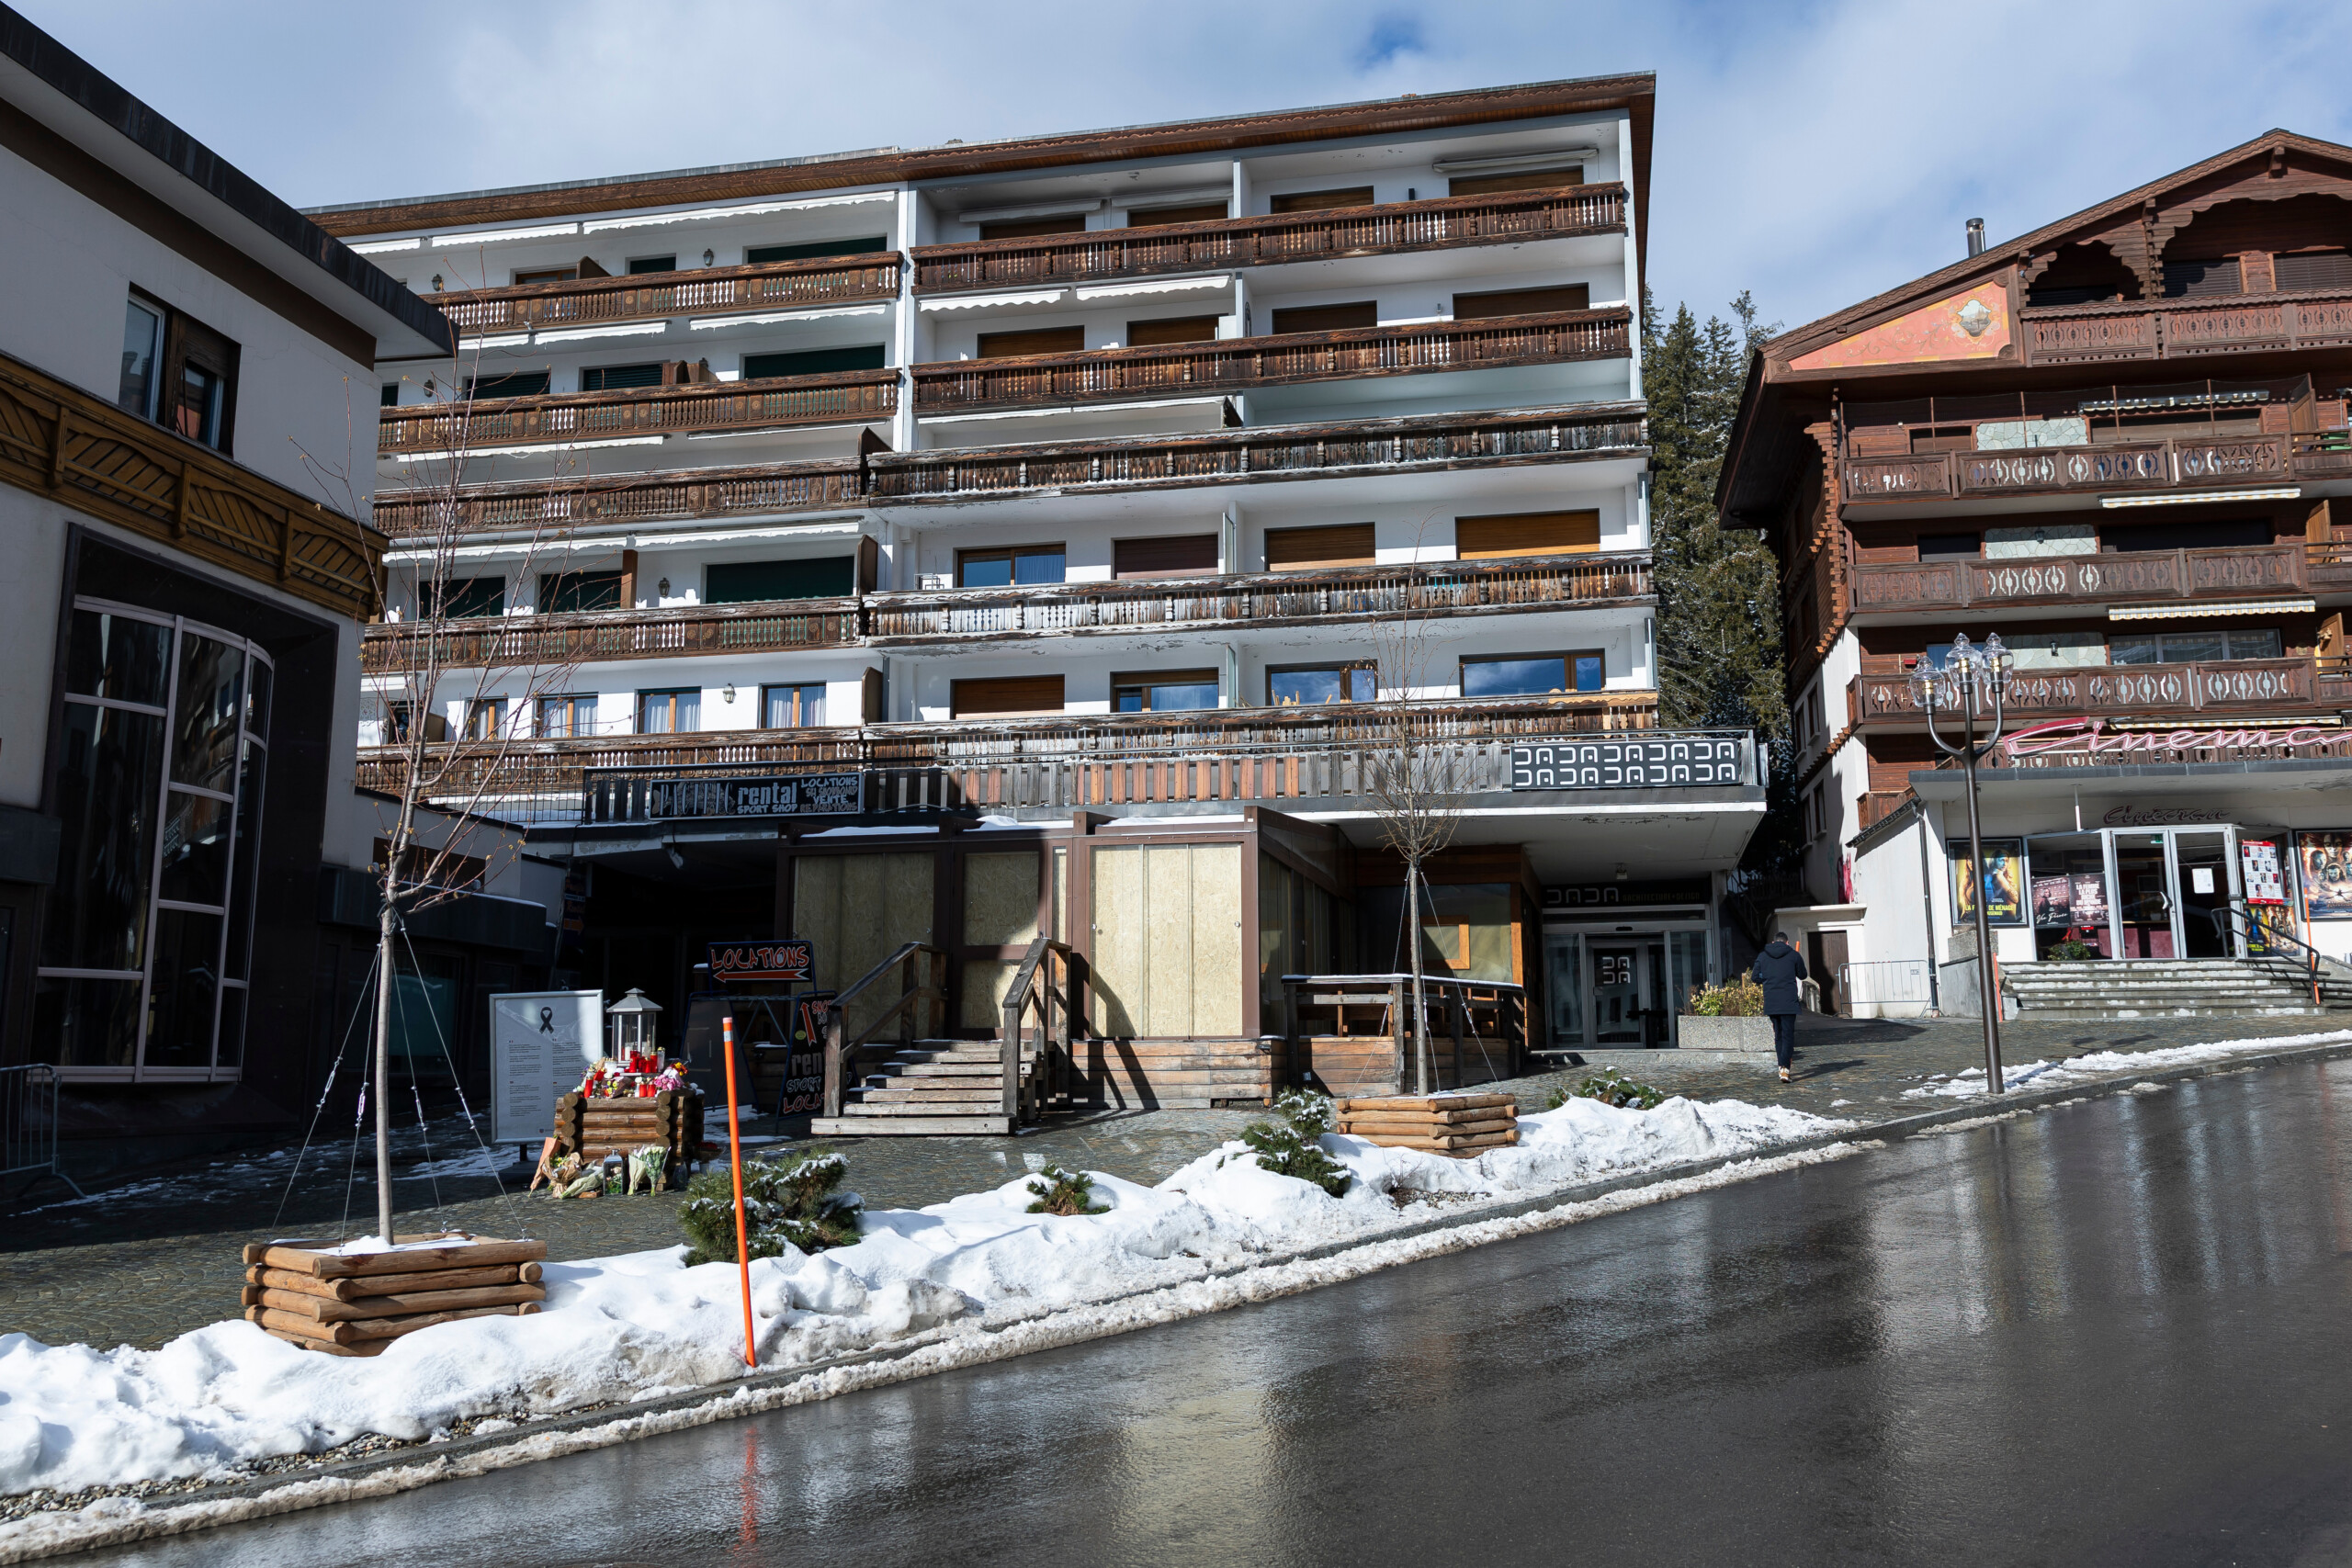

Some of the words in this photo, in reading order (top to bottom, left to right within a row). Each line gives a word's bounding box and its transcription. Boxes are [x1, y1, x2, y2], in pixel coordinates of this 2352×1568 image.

[800, 776, 858, 788] LOCATIONS
[659, 782, 735, 816] PACIFIC
[737, 782, 797, 805] rental
[813, 794, 849, 805] VENTE
[737, 805, 769, 815] SPORT
[772, 804, 797, 813] SHOP
[711, 945, 809, 970] LOCATIONS
[786, 1076, 822, 1093] SPORT
